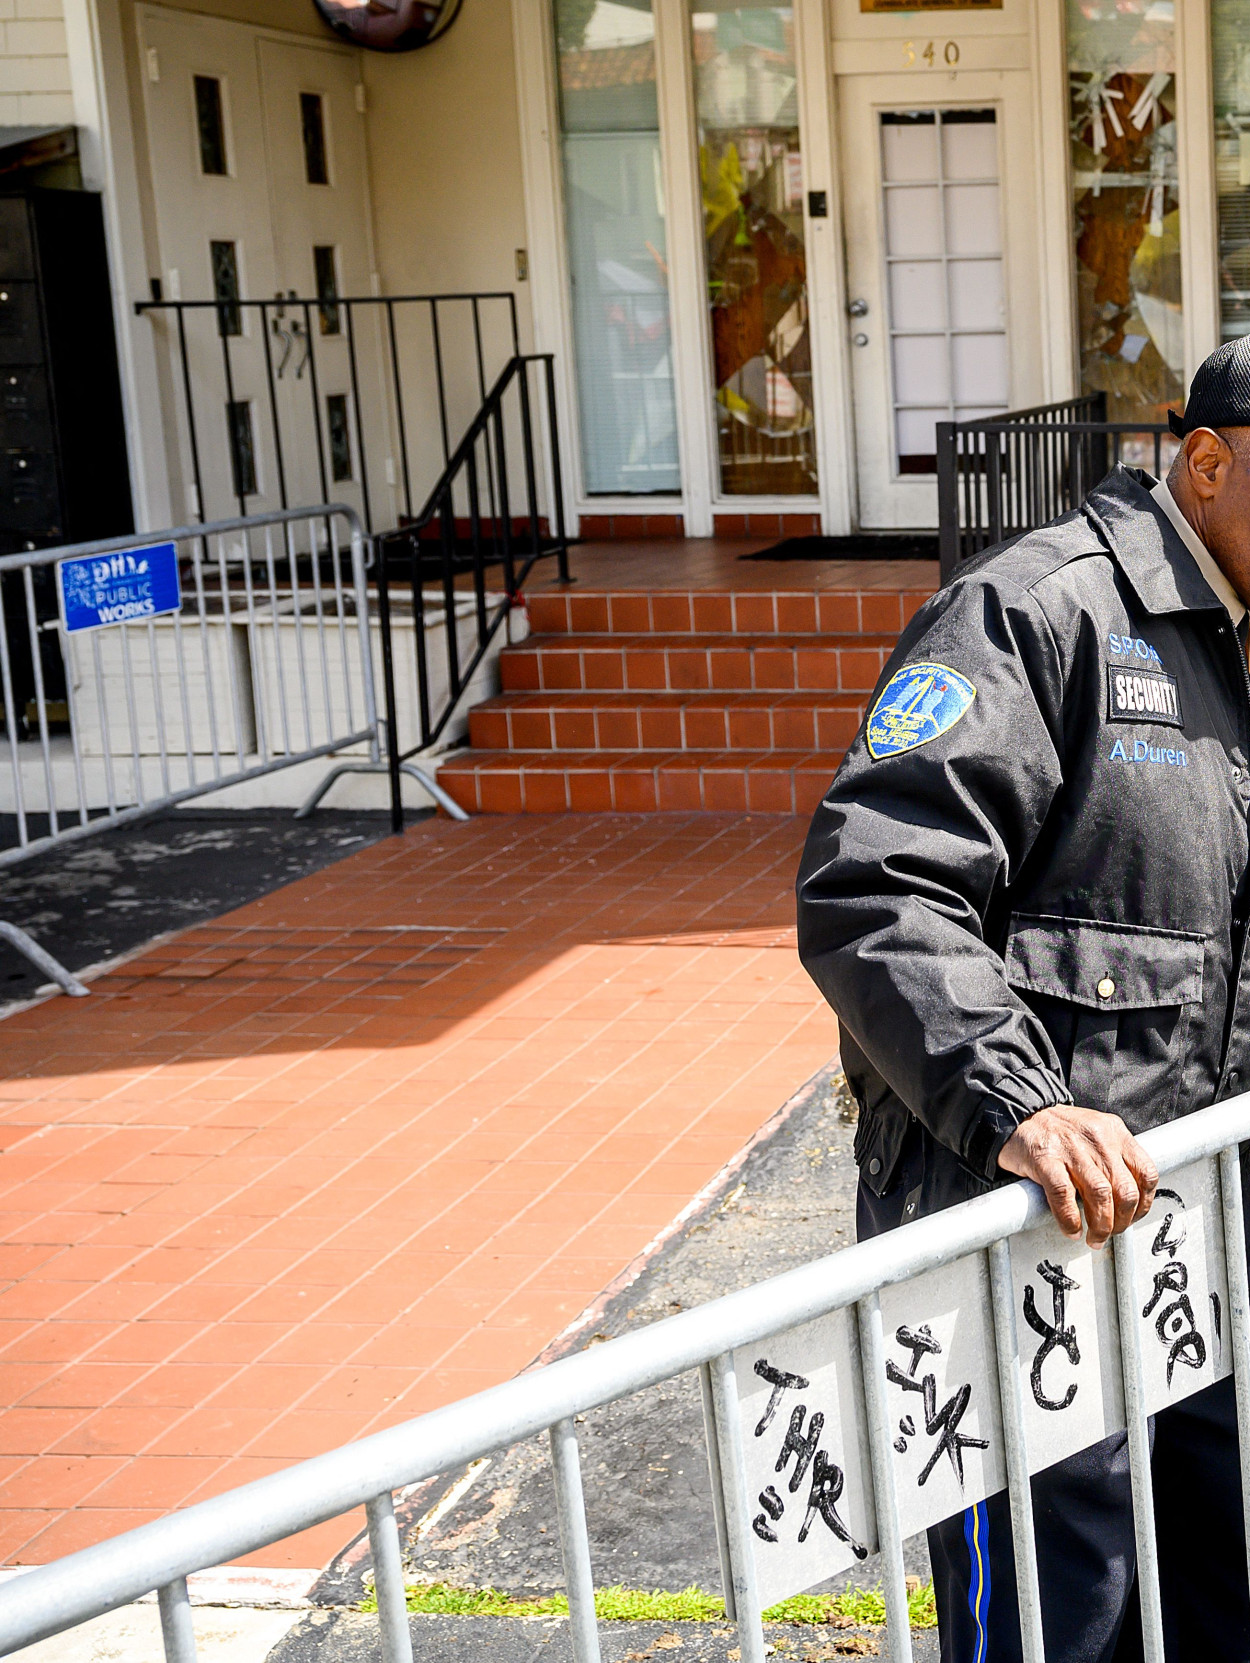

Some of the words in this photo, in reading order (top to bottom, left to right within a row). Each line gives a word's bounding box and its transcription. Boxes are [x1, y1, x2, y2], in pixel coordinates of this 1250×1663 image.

[902, 40, 960, 68] 540
[95, 581, 153, 605] PUBLIC
[97, 597, 156, 623] WORKS
[1115, 674, 1178, 716] SECURITY
[1109, 739, 1188, 767] A.Duren
